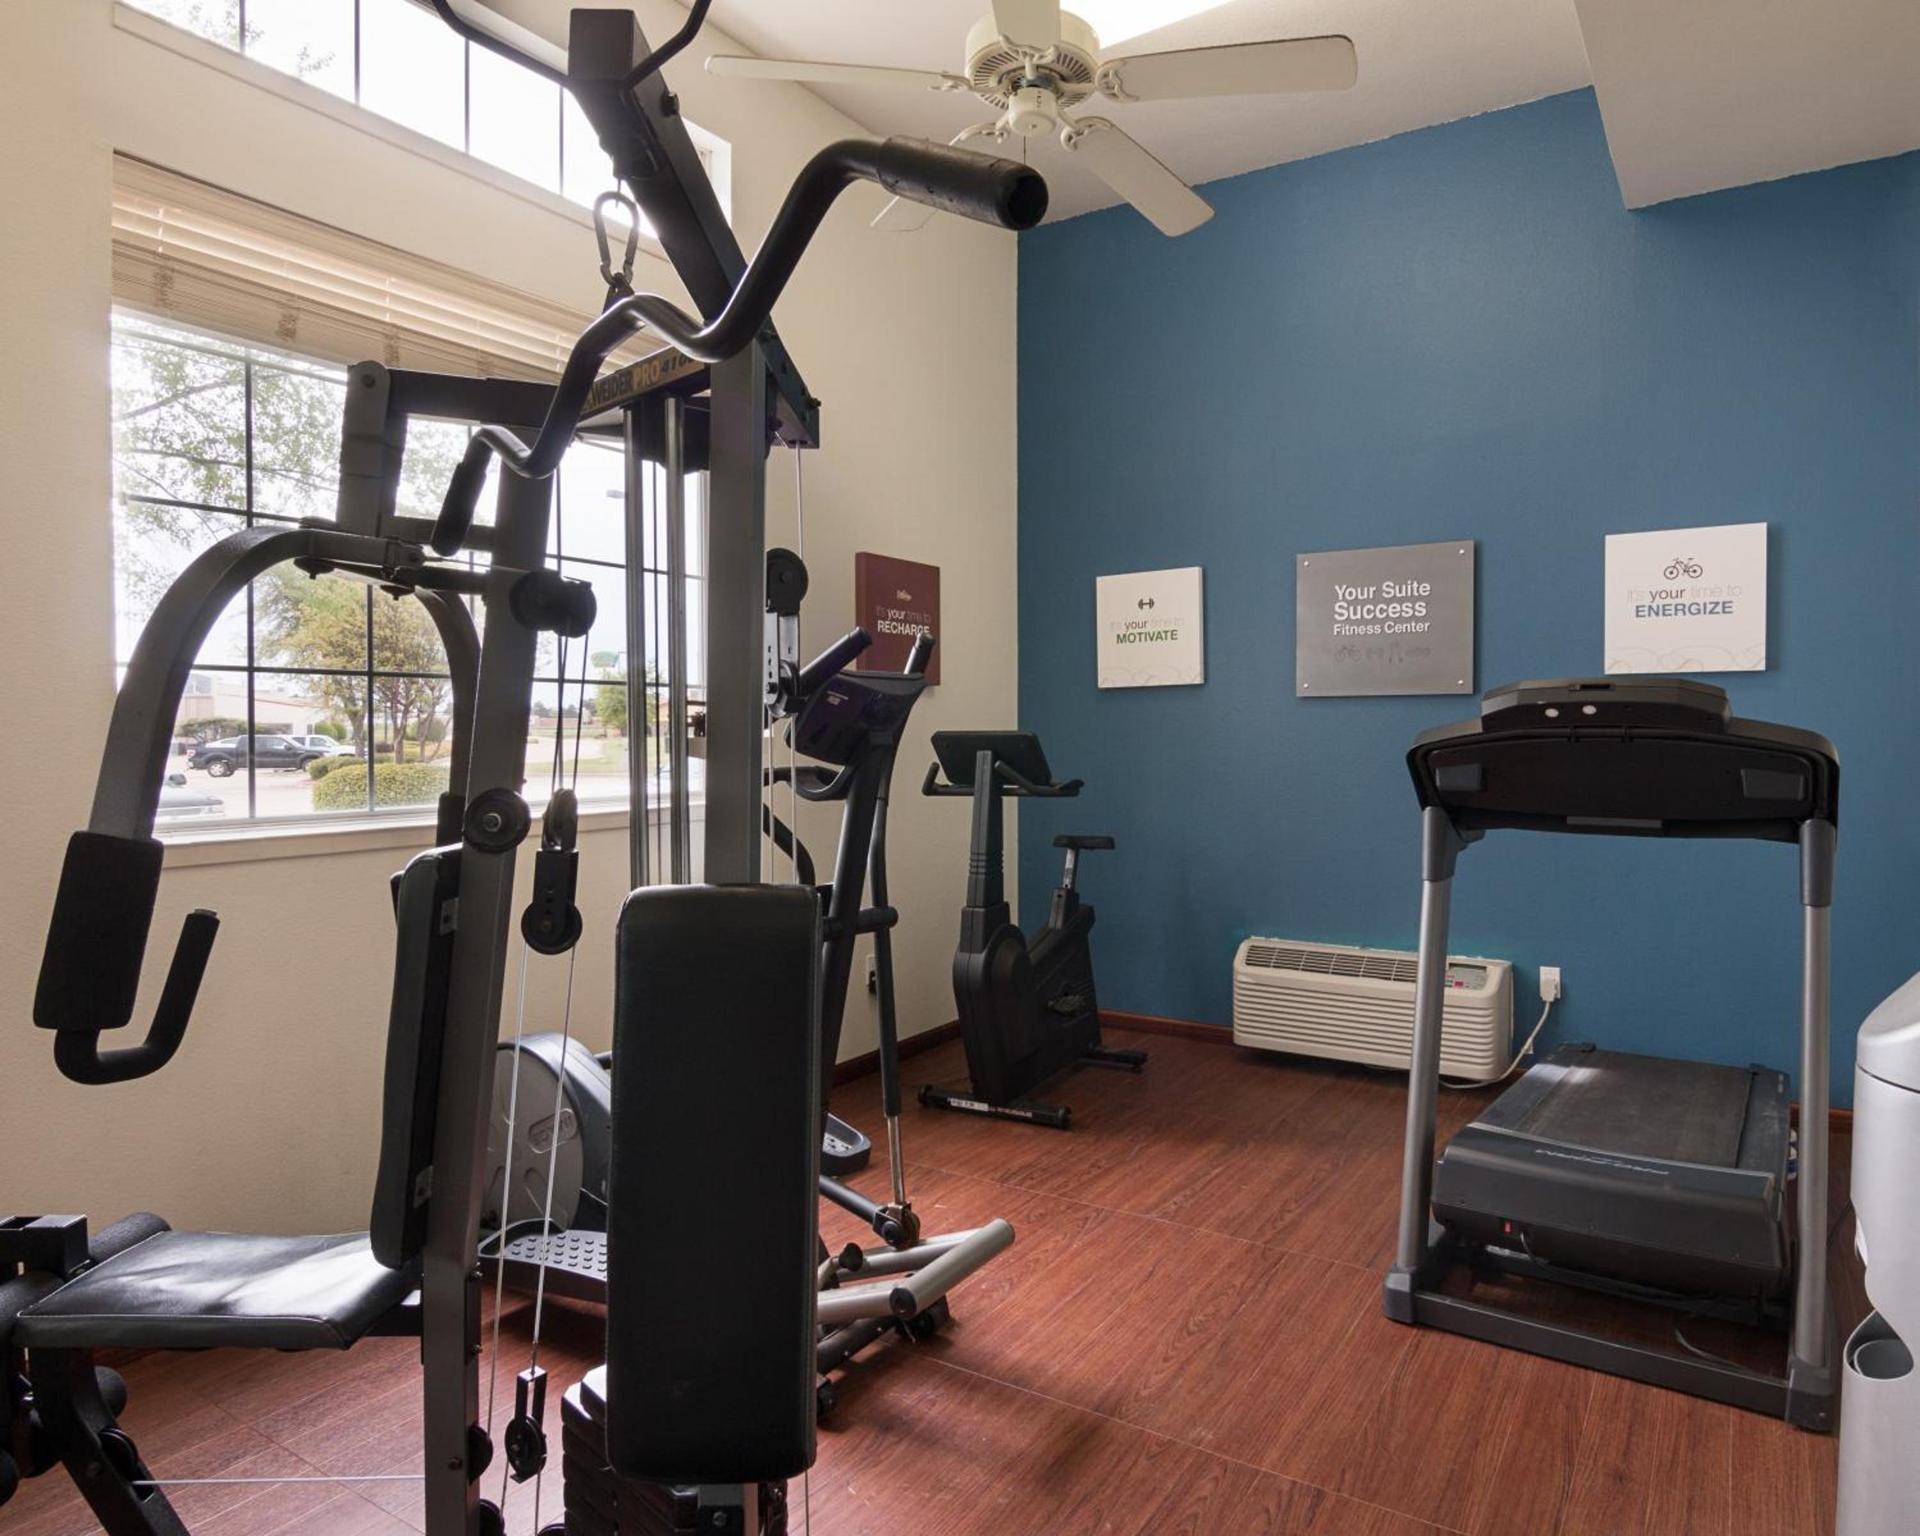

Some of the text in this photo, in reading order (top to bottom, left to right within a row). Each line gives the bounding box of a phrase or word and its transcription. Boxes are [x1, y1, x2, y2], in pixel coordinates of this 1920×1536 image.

[591, 370, 633, 407] WEIDER
[632, 358, 661, 391] PRO
[1334, 580, 1431, 601] Your Suite
[1649, 588, 1686, 603] your
[887, 608, 906, 620] your
[1333, 601, 1427, 620] Success
[1635, 600, 1734, 618] ENERGIZE
[1124, 620, 1149, 631] your
[1333, 620, 1430, 635] Fitness Center
[1116, 629, 1178, 644] MOTIVATE
